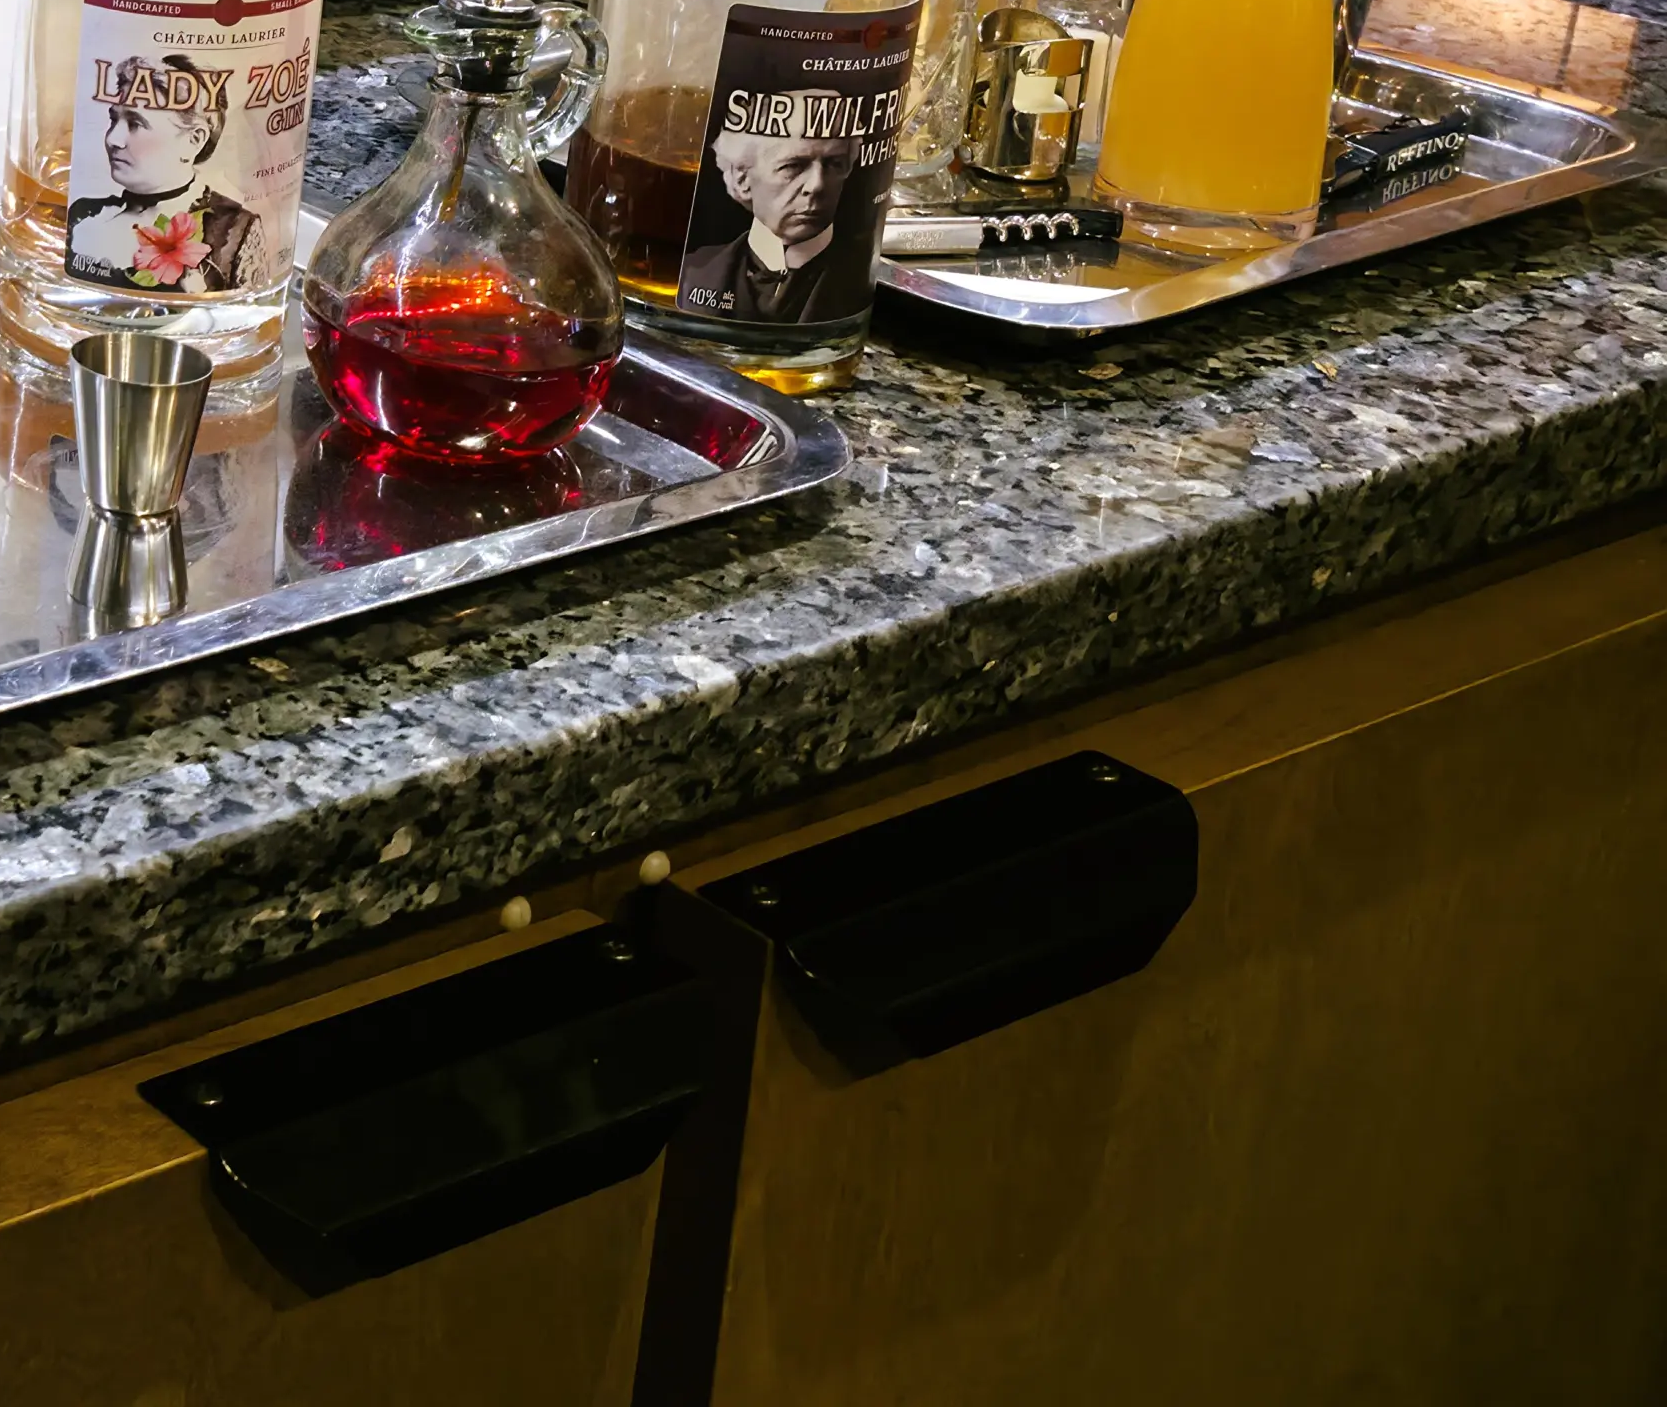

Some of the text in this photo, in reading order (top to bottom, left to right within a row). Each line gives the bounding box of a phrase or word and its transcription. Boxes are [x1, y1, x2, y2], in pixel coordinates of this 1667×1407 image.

[112, 0, 181, 15] HANDCRAFTED
[271, 0, 293, 11] SMALL
[153, 27, 286, 44] CHÂTEAU LAURIER
[760, 27, 834, 41] HANDCRAFTED
[802, 57, 870, 71] CHÂTEAU
[92, 58, 234, 112] LADY
[267, 101, 306, 136] GIN
[724, 88, 902, 139] SIR WILFRI
[860, 138, 898, 167] WHIS
[1387, 132, 1459, 172] RUFFINO
[71, 254, 97, 274] 40%
[688, 287, 717, 308] 40%
